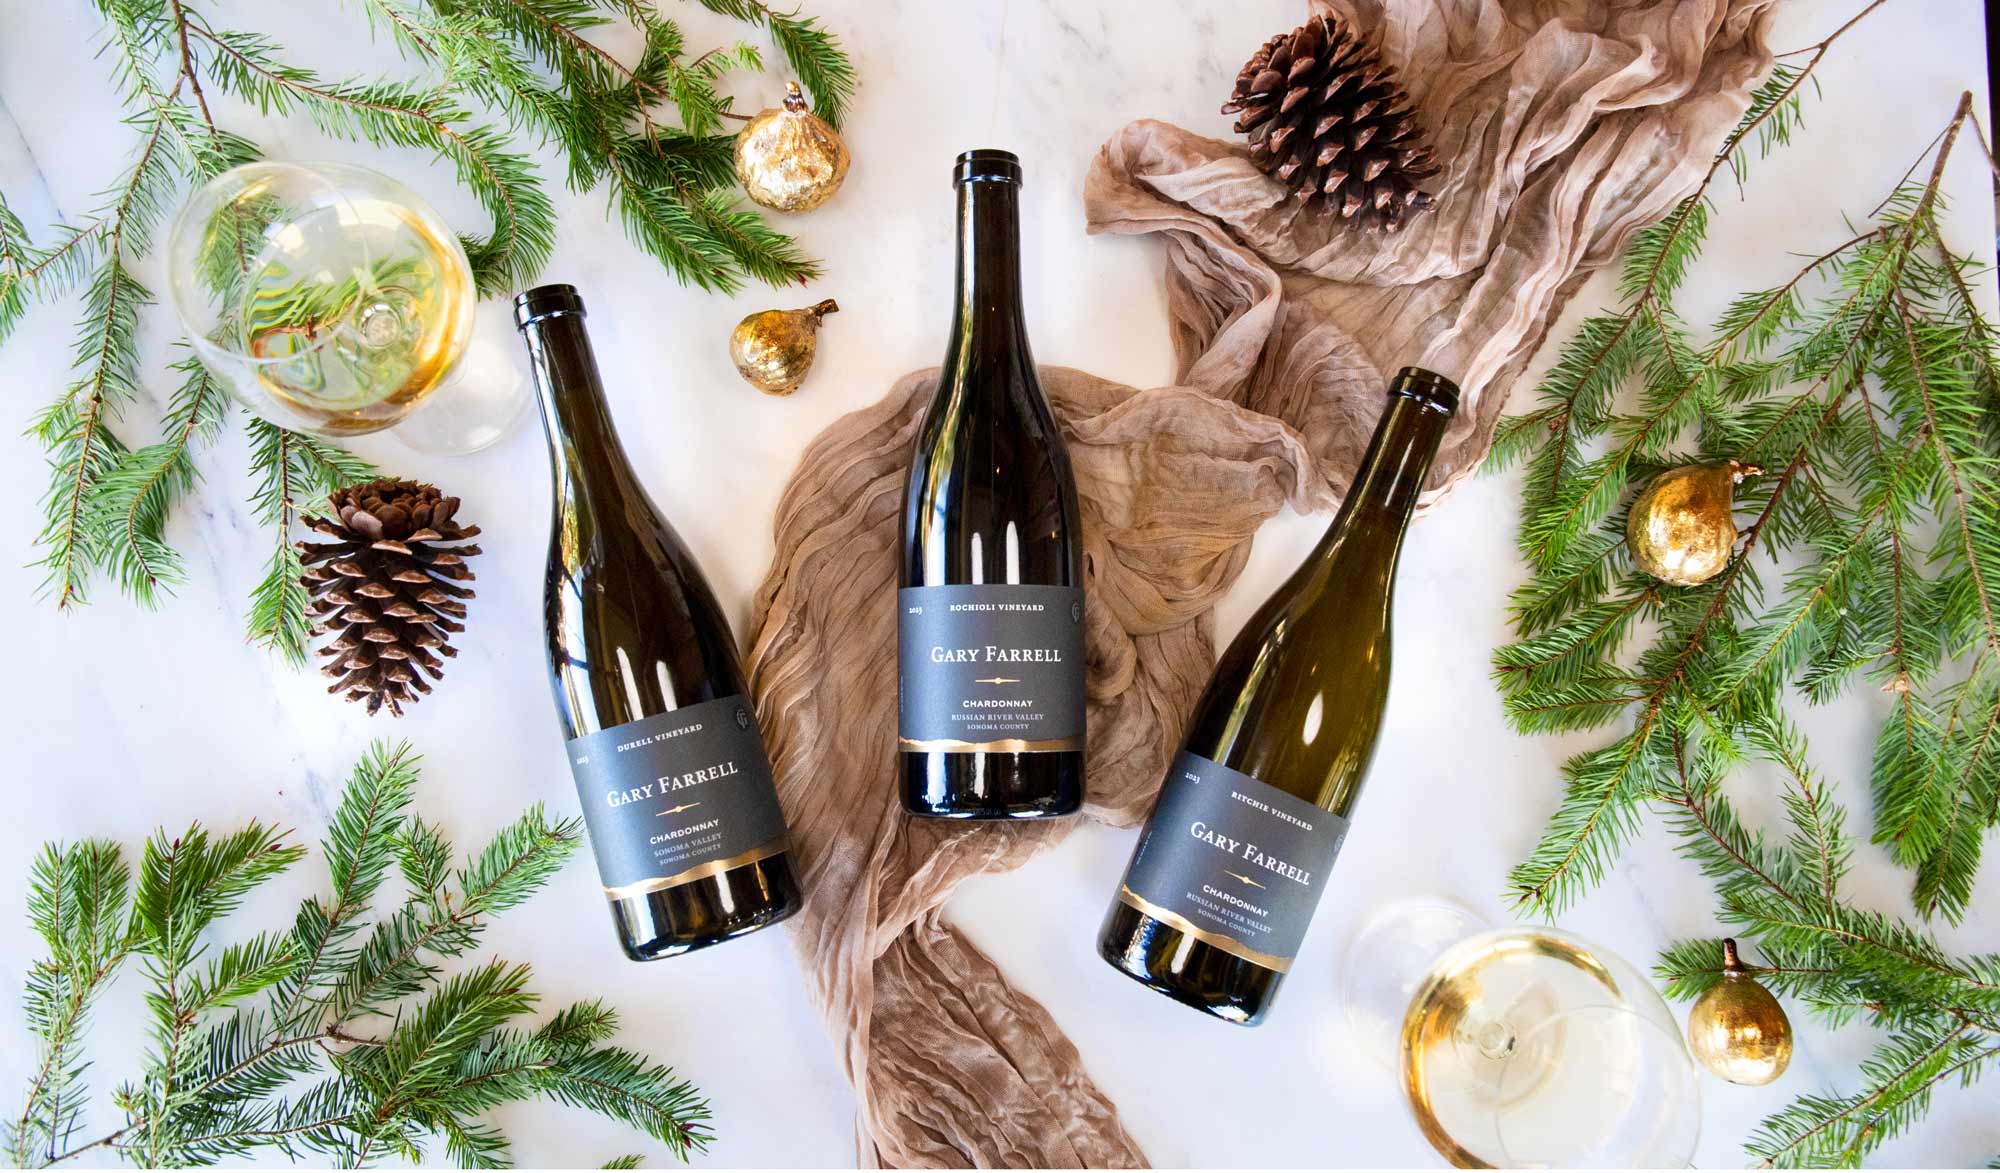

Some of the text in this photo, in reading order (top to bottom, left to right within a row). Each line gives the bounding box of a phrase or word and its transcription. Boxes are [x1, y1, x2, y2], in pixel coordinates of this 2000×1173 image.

[931, 646, 1061, 662] GARY FARRELL
[963, 700, 1032, 708] CHARDONNAY
[1015, 713, 1044, 721] VALLEY
[617, 723, 703, 752] DURELL VINEYARD
[606, 761, 738, 808] GARY FARRELL
[1231, 791, 1313, 832] RITCHIE VINEYARD
[650, 819, 720, 844] CHARDONNAY
[654, 832, 722, 857] SONOMA VALLEY
[660, 843, 722, 865] SONOMA COUNTY
[1190, 821, 1241, 854] GARY
[1243, 843, 1311, 886] FARRELL
[1186, 891, 1272, 934] RUSSIAN RIVER VALLEY
[1203, 884, 1268, 917] CHARDONNAY
[1198, 908, 1256, 937] SONOMA COUNTY
